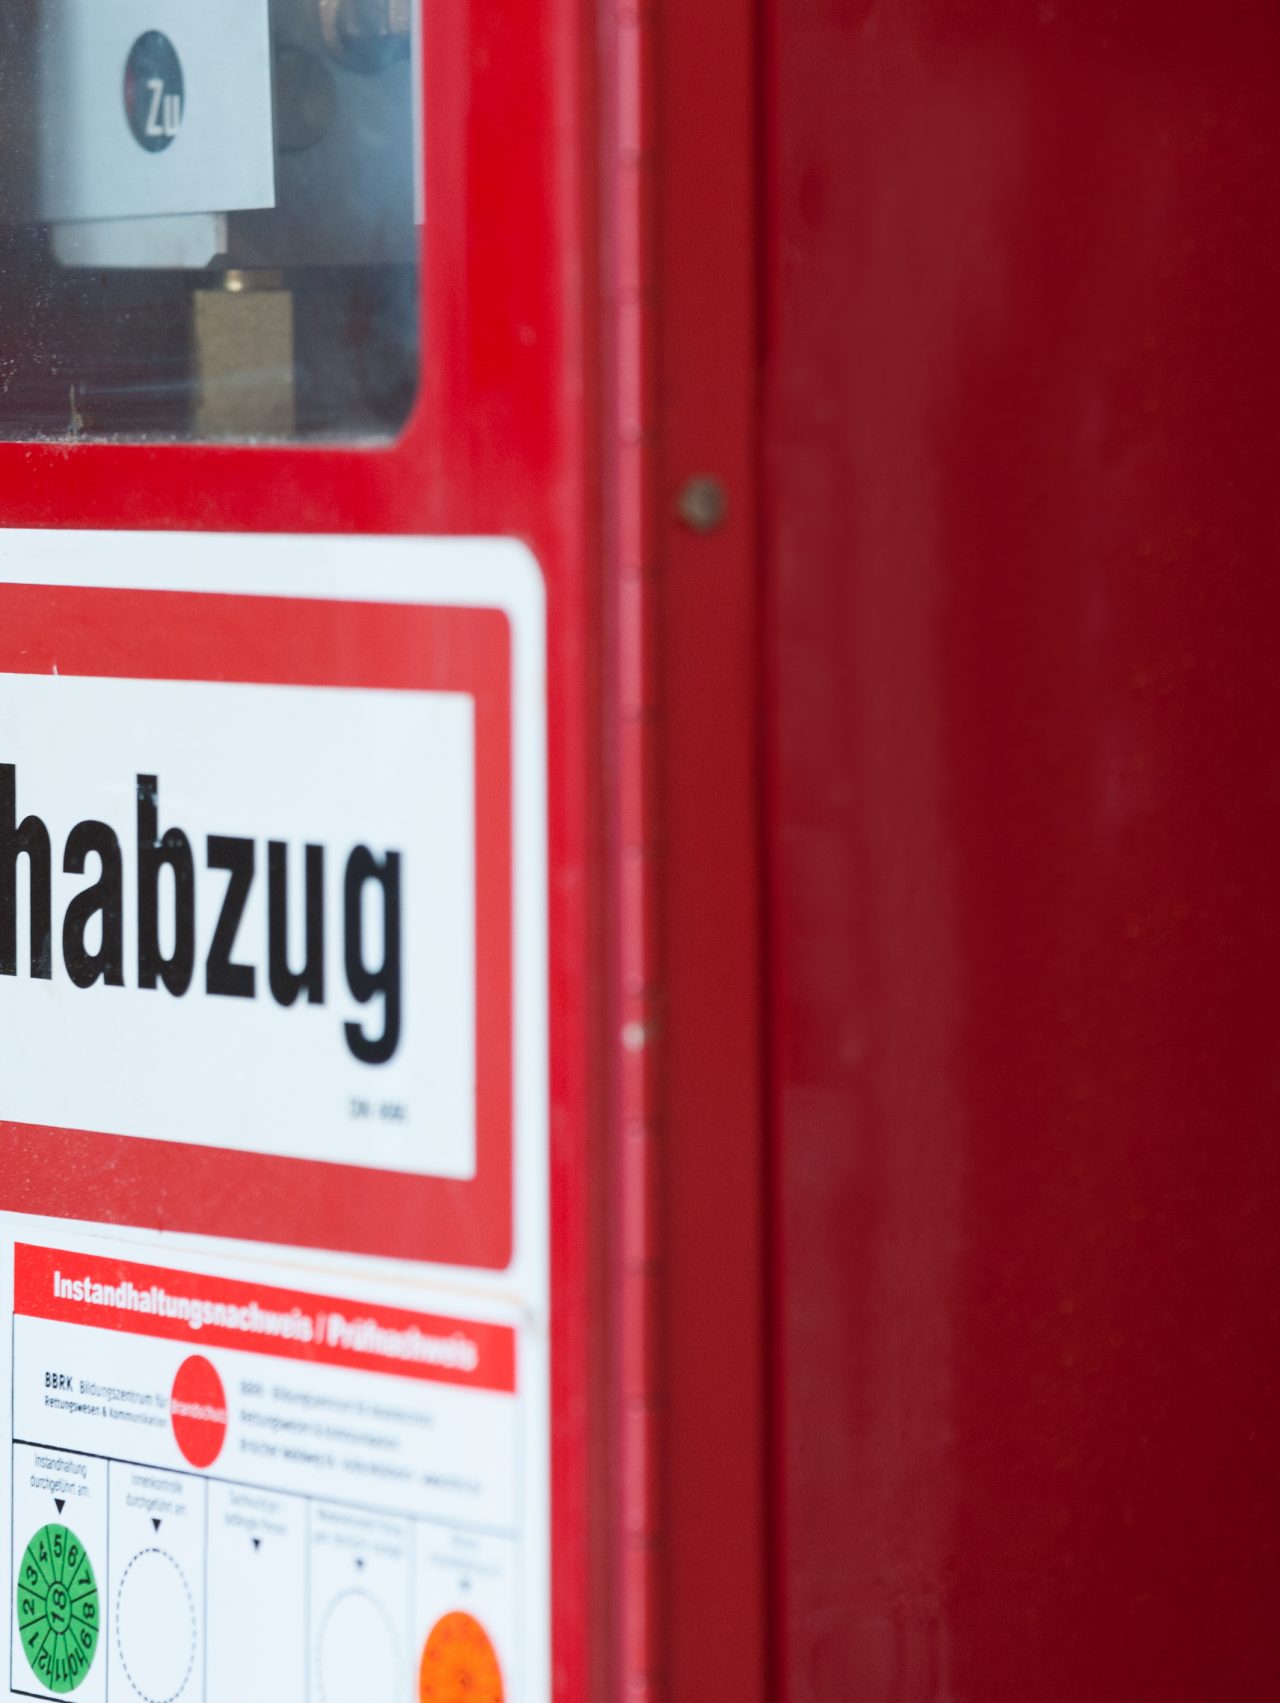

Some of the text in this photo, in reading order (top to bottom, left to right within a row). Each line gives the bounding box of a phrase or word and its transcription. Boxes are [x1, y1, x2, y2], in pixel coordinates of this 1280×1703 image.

[146, 79, 180, 137] Zu
[53, 1270, 312, 1342] Instandhaltungsnachweis
[315, 1312, 327, 1344] /
[45, 1372, 73, 1392] BBRK
[44, 1395, 100, 1416] Rettungswesen
[34, 1453, 87, 1478] Instandhaltung
[39, 1541, 48, 1563] 4
[54, 1534, 62, 1558] 5
[68, 1545, 78, 1567] 6
[26, 1565, 38, 1586] 3
[78, 1569, 92, 1587] 7
[23, 1598, 35, 1616] 2
[50, 1589, 67, 1624] 18
[82, 1602, 96, 1619] 8
[28, 1631, 39, 1648] 1
[80, 1628, 93, 1649] 9
[38, 1648, 53, 1677] 12
[55, 1658, 68, 1683] 11
[68, 1647, 84, 1677] 10
